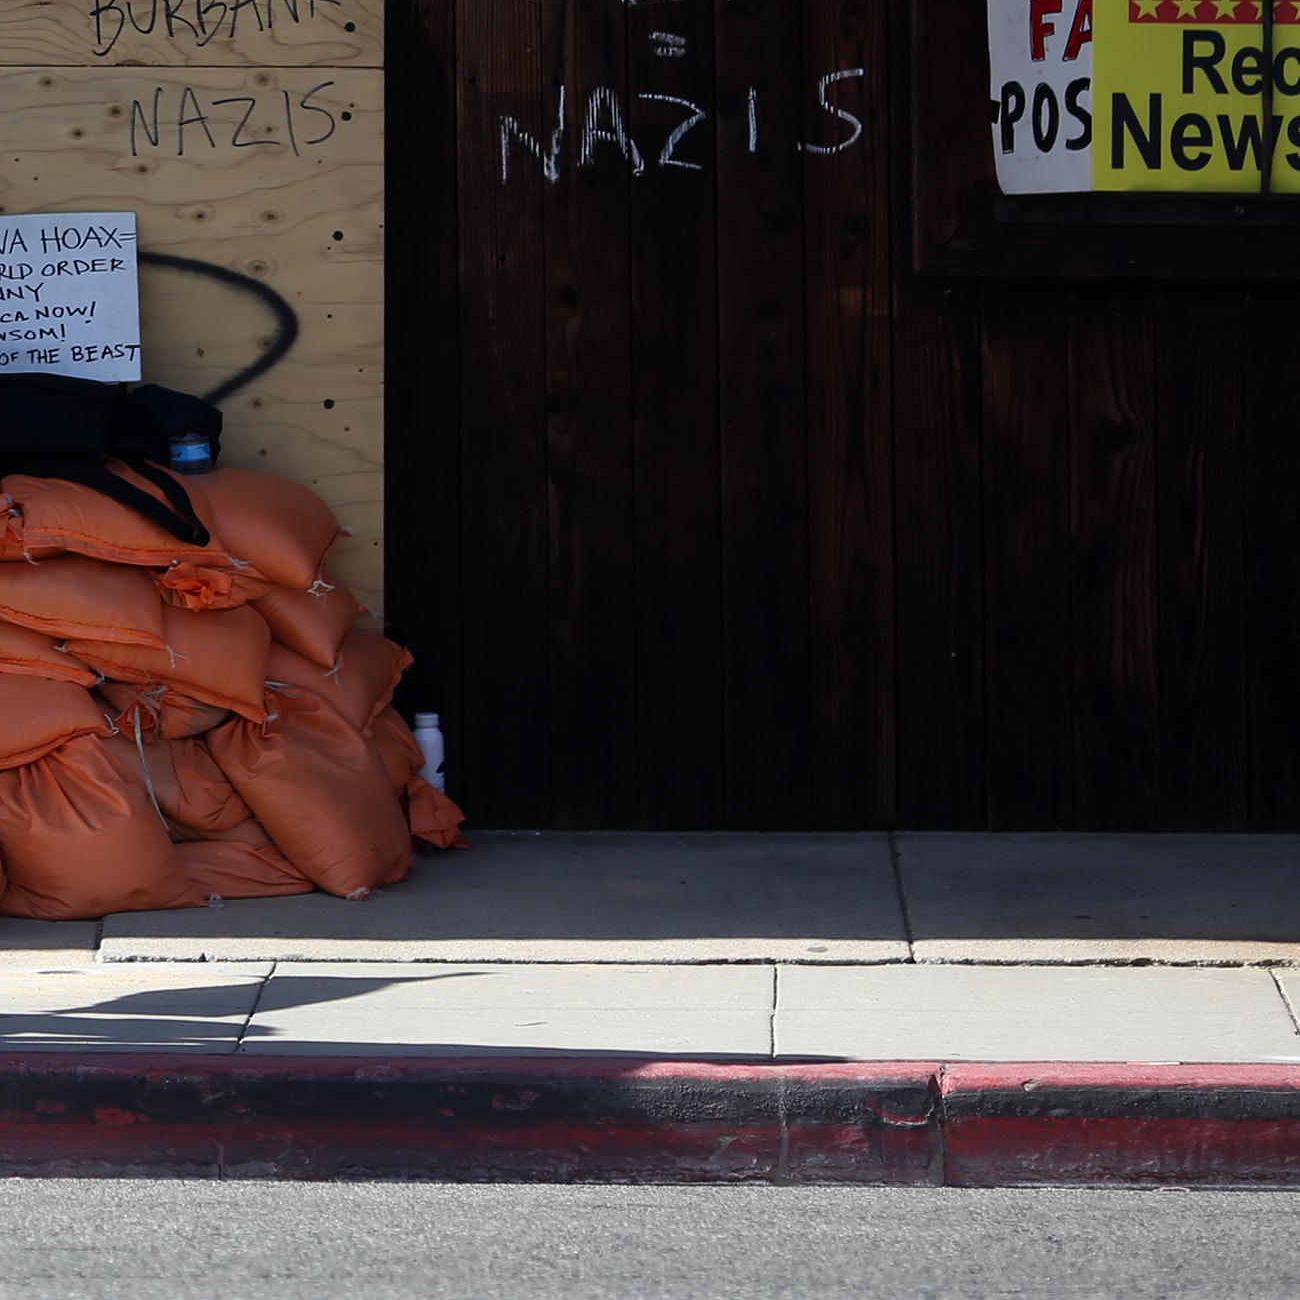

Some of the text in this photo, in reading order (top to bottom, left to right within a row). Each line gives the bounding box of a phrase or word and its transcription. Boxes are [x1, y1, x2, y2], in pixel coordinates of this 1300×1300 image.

[130, 81, 336, 157] NAZIS
[40, 257, 126, 277] ORDER
[34, 300, 97, 325] NOW!
[26, 348, 61, 365] THE
[71, 343, 142, 364] BEAST
